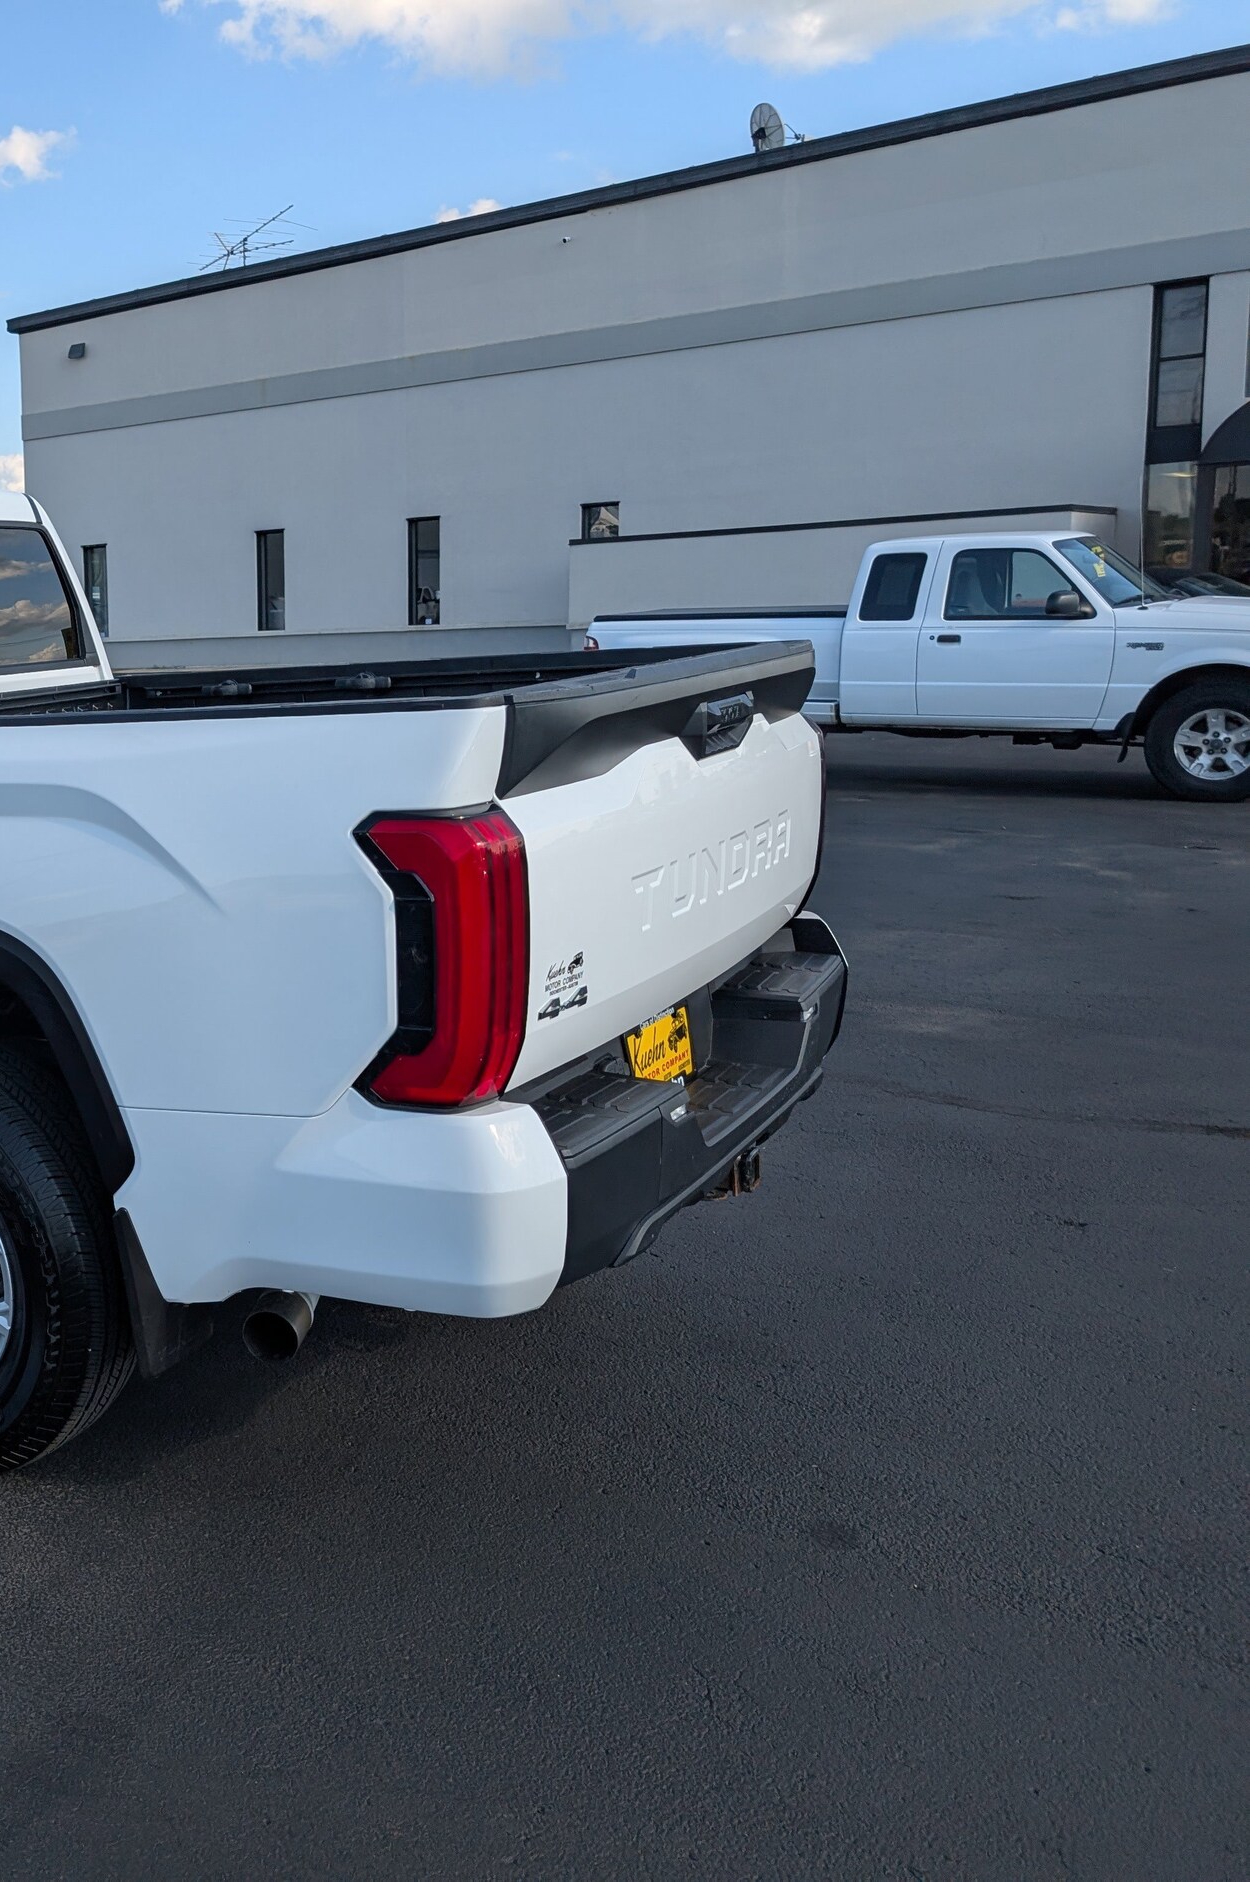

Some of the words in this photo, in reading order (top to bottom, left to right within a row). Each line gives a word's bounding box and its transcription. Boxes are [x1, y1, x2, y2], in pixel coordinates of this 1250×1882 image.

[631, 808, 792, 933] TUNDRA
[545, 979, 562, 992] MOTOR
[562, 970, 584, 986] COMPANY
[633, 1025, 667, 1077] Kuehn
[661, 1049, 689, 1073] COMPANY
